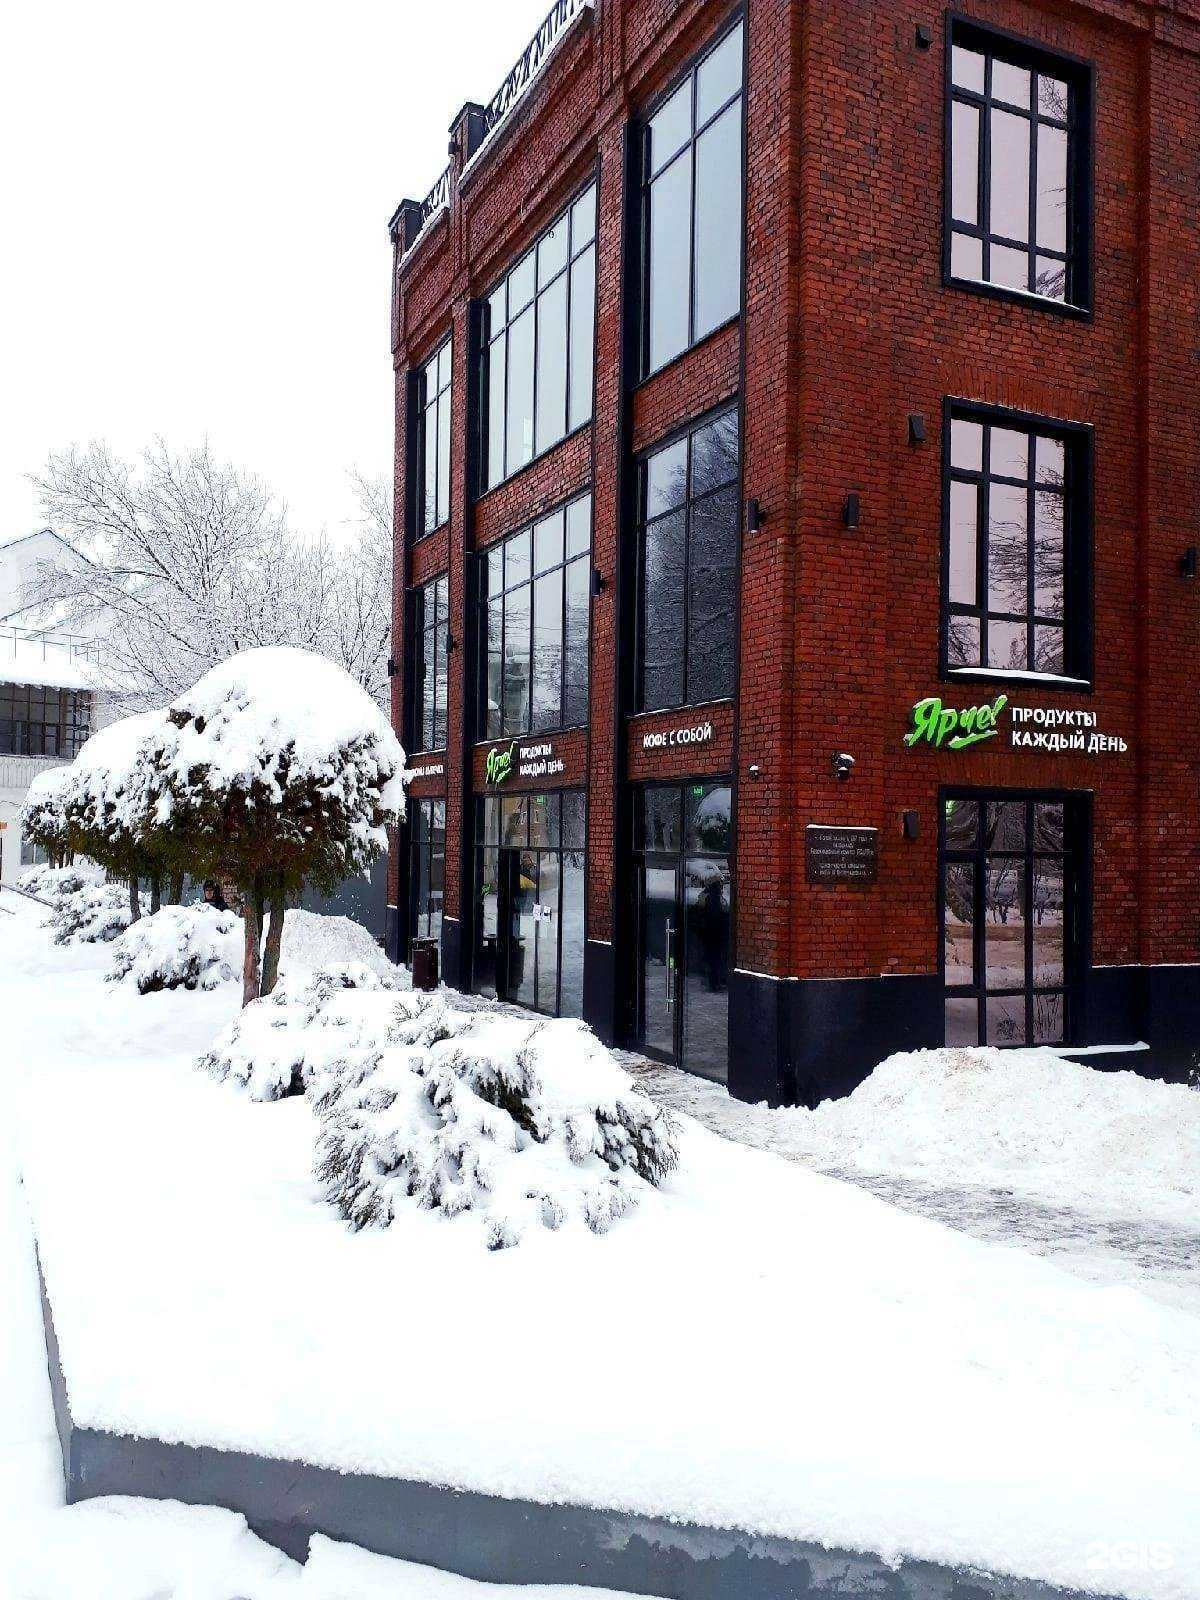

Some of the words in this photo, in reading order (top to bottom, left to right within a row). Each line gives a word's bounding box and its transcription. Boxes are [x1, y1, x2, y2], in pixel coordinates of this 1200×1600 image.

[903, 694, 1008, 749] Ярче!
[1011, 706, 1097, 727] ПРОДУКТЫ
[643, 731, 667, 748] КОФЕ
[669, 729, 676, 745] С
[677, 721, 712, 743] СОБОЙ
[1011, 730, 1085, 752] КАЖДЫЙ
[1088, 732, 1129, 753] ДЕНЬ
[519, 759, 547, 777] КАЖДЫЙ
[547, 759, 564, 775] ДЕНЬ
